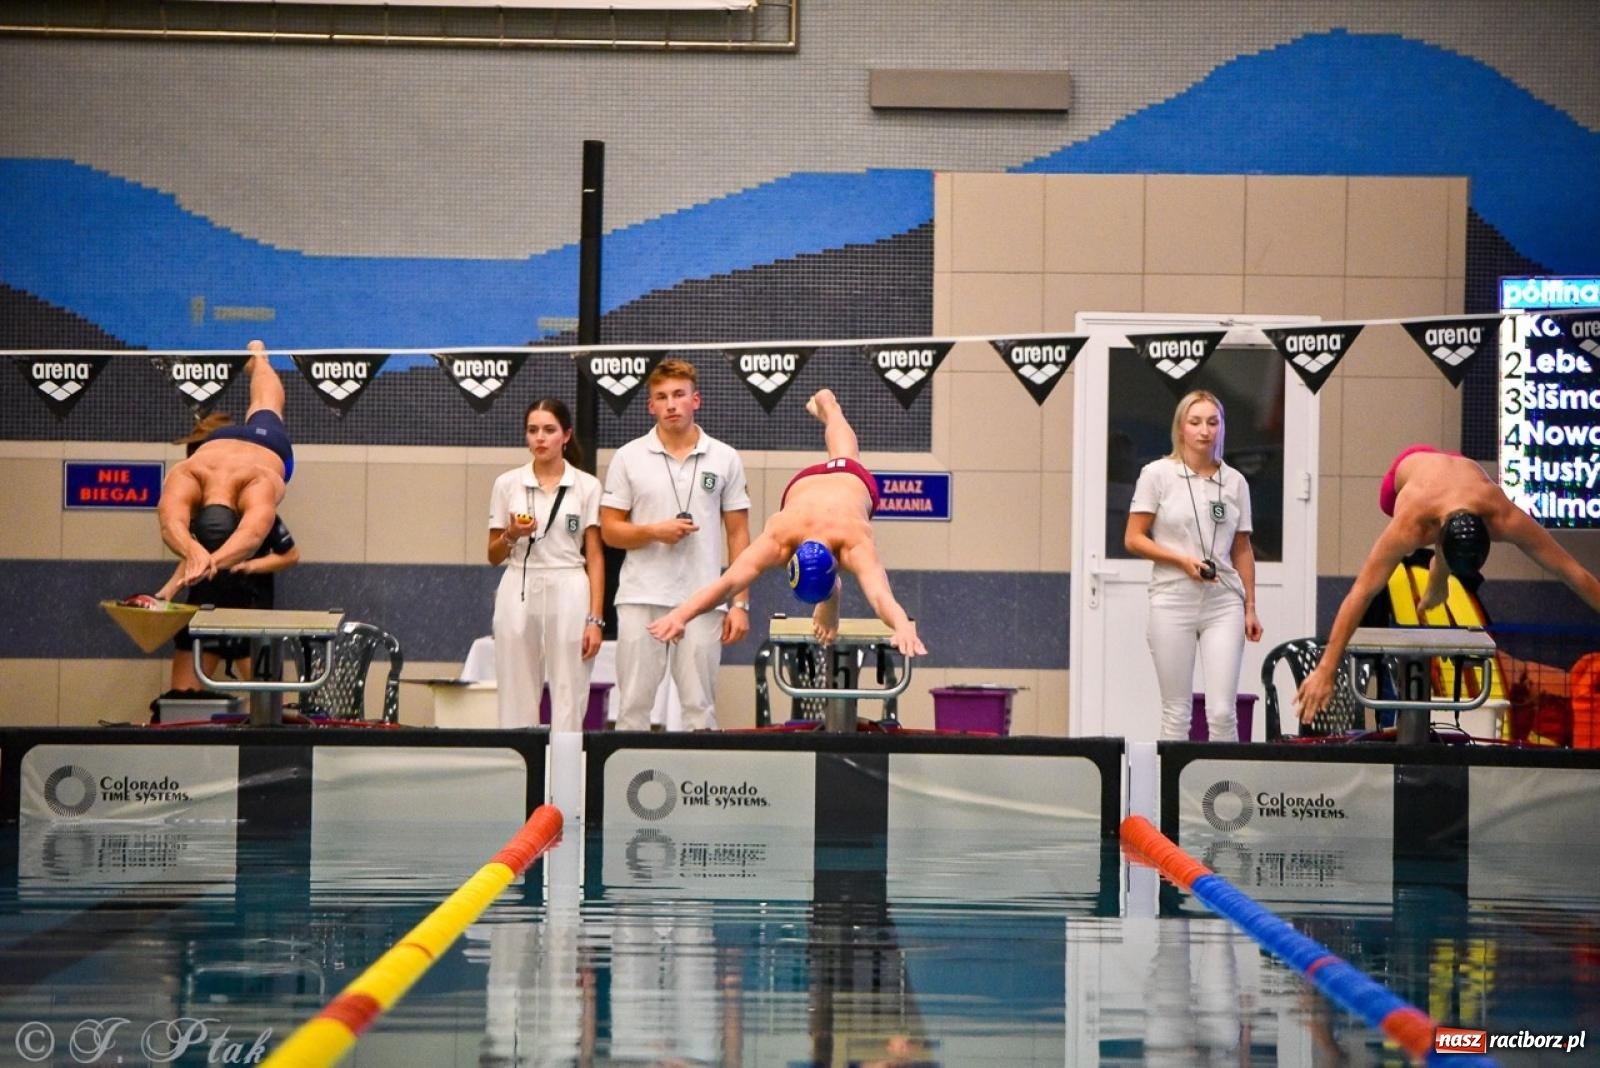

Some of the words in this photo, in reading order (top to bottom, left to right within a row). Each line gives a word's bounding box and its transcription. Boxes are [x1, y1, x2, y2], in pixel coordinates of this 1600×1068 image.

[1286, 333, 1341, 352] arena
[1425, 327, 1481, 345] arena
[1011, 345, 1066, 364] arena
[1149, 339, 1204, 358] arena
[453, 359, 509, 377] arena
[591, 356, 646, 375] arena
[740, 353, 796, 372] arena
[878, 349, 933, 368] arena
[1504, 351, 1522, 379] 2
[32, 363, 89, 379] arena
[172, 363, 229, 380] arena
[312, 360, 367, 379] arena
[1504, 387, 1522, 415] 3
[1504, 424, 1522, 451] 4
[98, 469, 131, 483] NIE
[1504, 459, 1521, 487] 5
[80, 487, 149, 502] BIEGAJ
[883, 479, 923, 494] ZAKAZ
[876, 497, 933, 512] KAKANIA
[1405, 660, 1425, 700] 6
[102, 791, 131, 801] TIME
[682, 797, 710, 806] TIME
[1258, 807, 1287, 818] TIME
